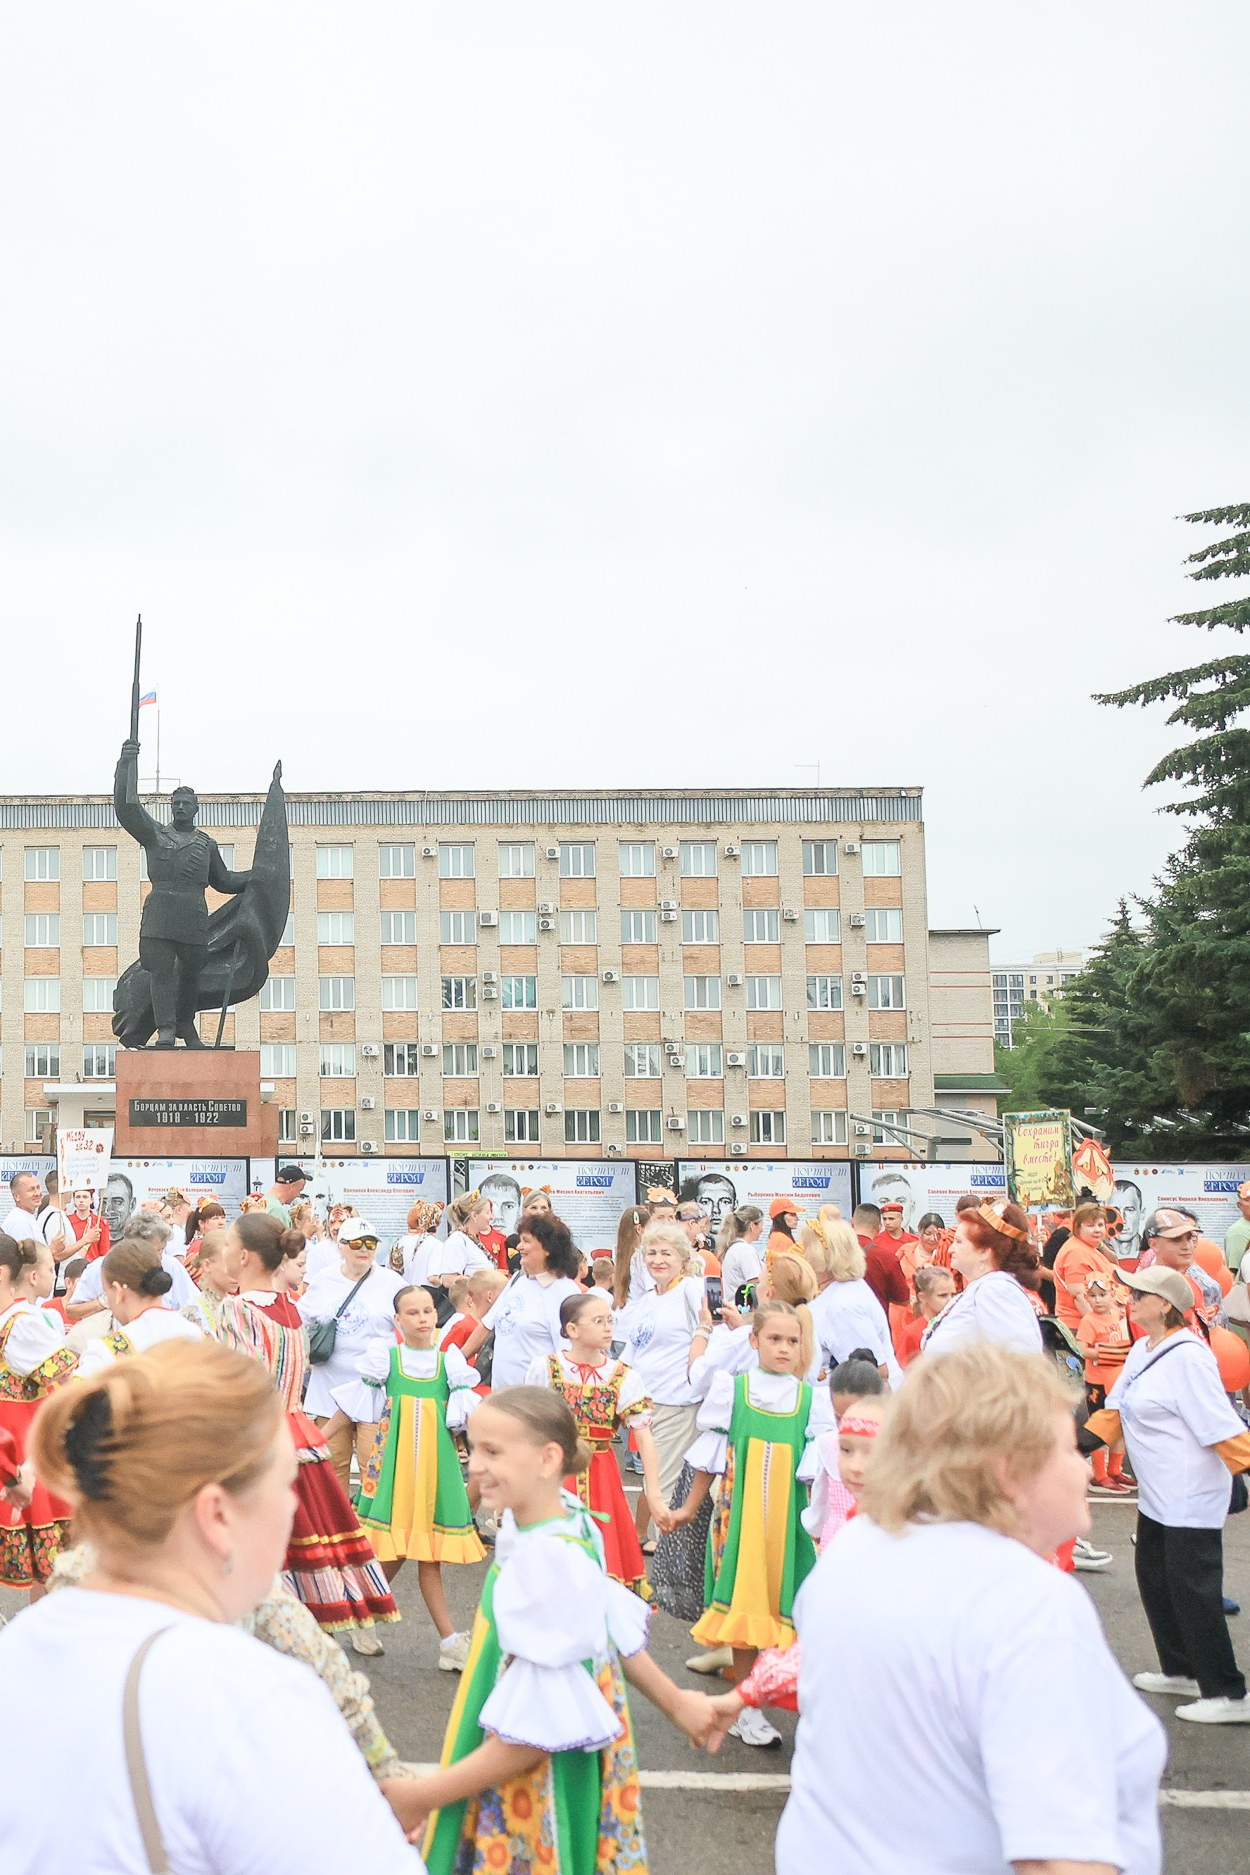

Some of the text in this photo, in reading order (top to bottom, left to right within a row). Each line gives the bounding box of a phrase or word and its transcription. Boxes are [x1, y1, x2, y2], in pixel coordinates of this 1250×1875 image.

[156, 1112, 181, 1123] 1918
[194, 1112, 219, 1123] 1922
[1017, 1125, 1059, 1139] Сохраним
[1033, 1138, 1059, 1152] тигра
